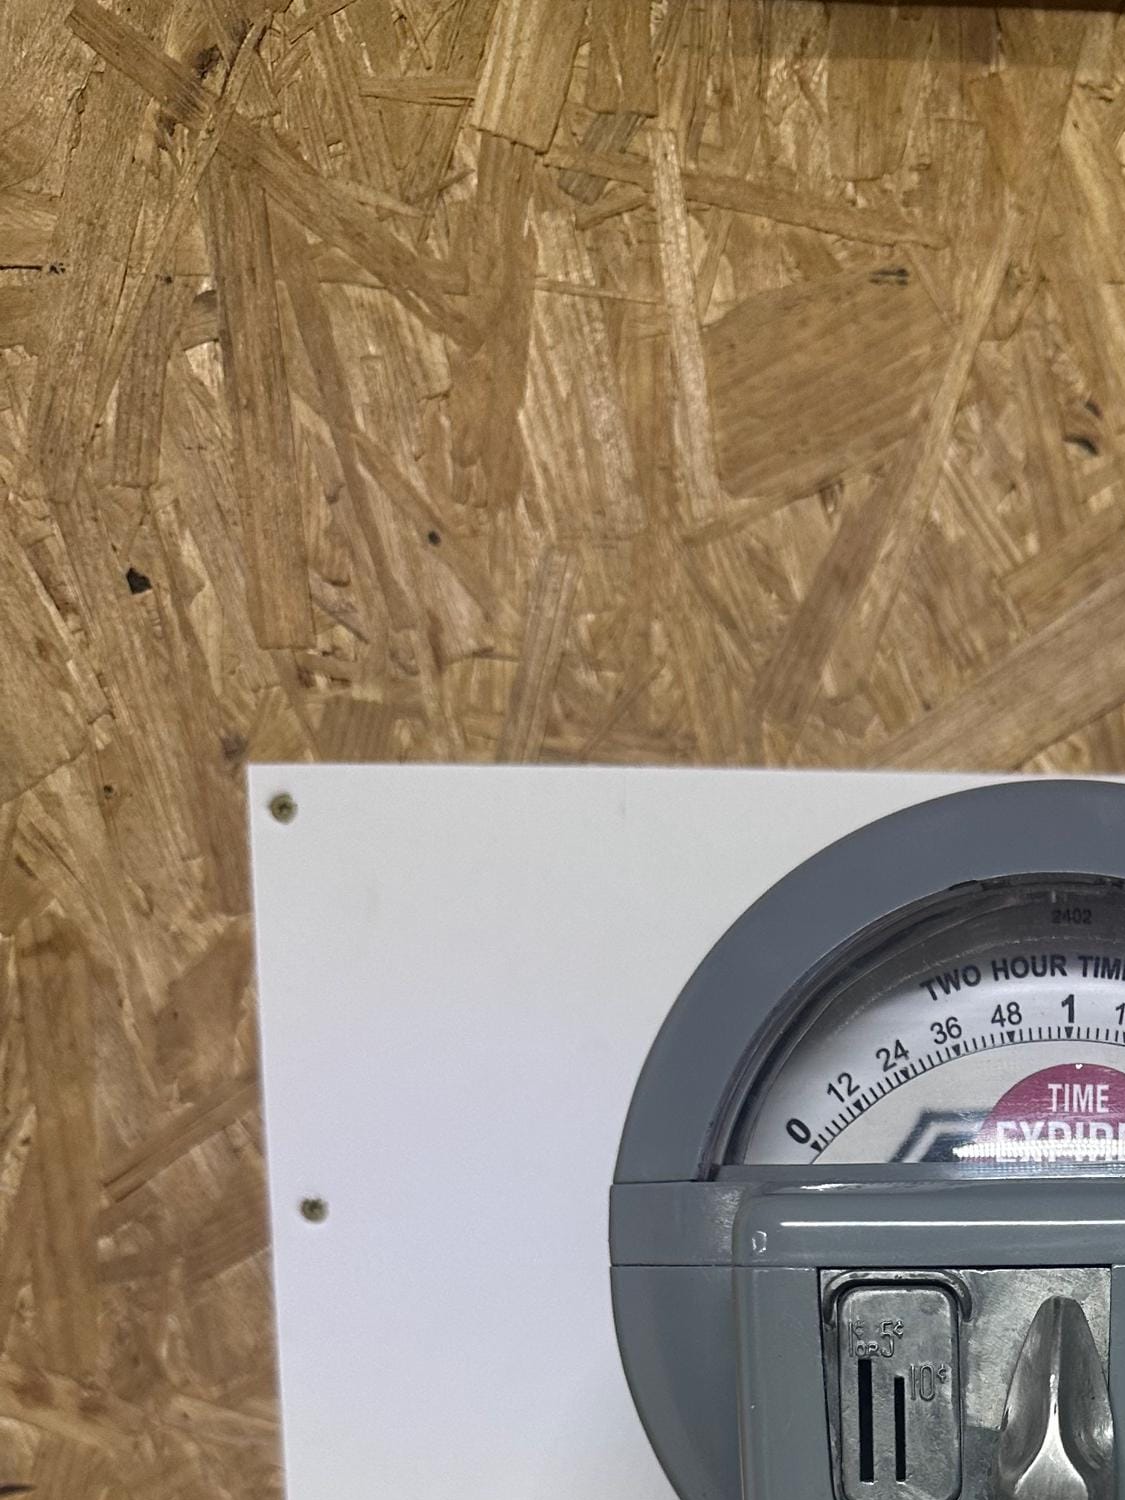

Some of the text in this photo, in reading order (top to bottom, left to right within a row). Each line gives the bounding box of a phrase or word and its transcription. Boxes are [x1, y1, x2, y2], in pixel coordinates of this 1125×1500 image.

[920, 964, 981, 1003] TWO
[992, 955, 1067, 981] HOUR
[785, 1117, 812, 1145] 0
[827, 1072, 861, 1104] 12
[875, 1039, 909, 1073] 24
[930, 1016, 963, 1045] 36
[991, 1002, 1022, 1027] 48
[1060, 994, 1076, 1023] 1
[1048, 1083, 1108, 1113] TIME
